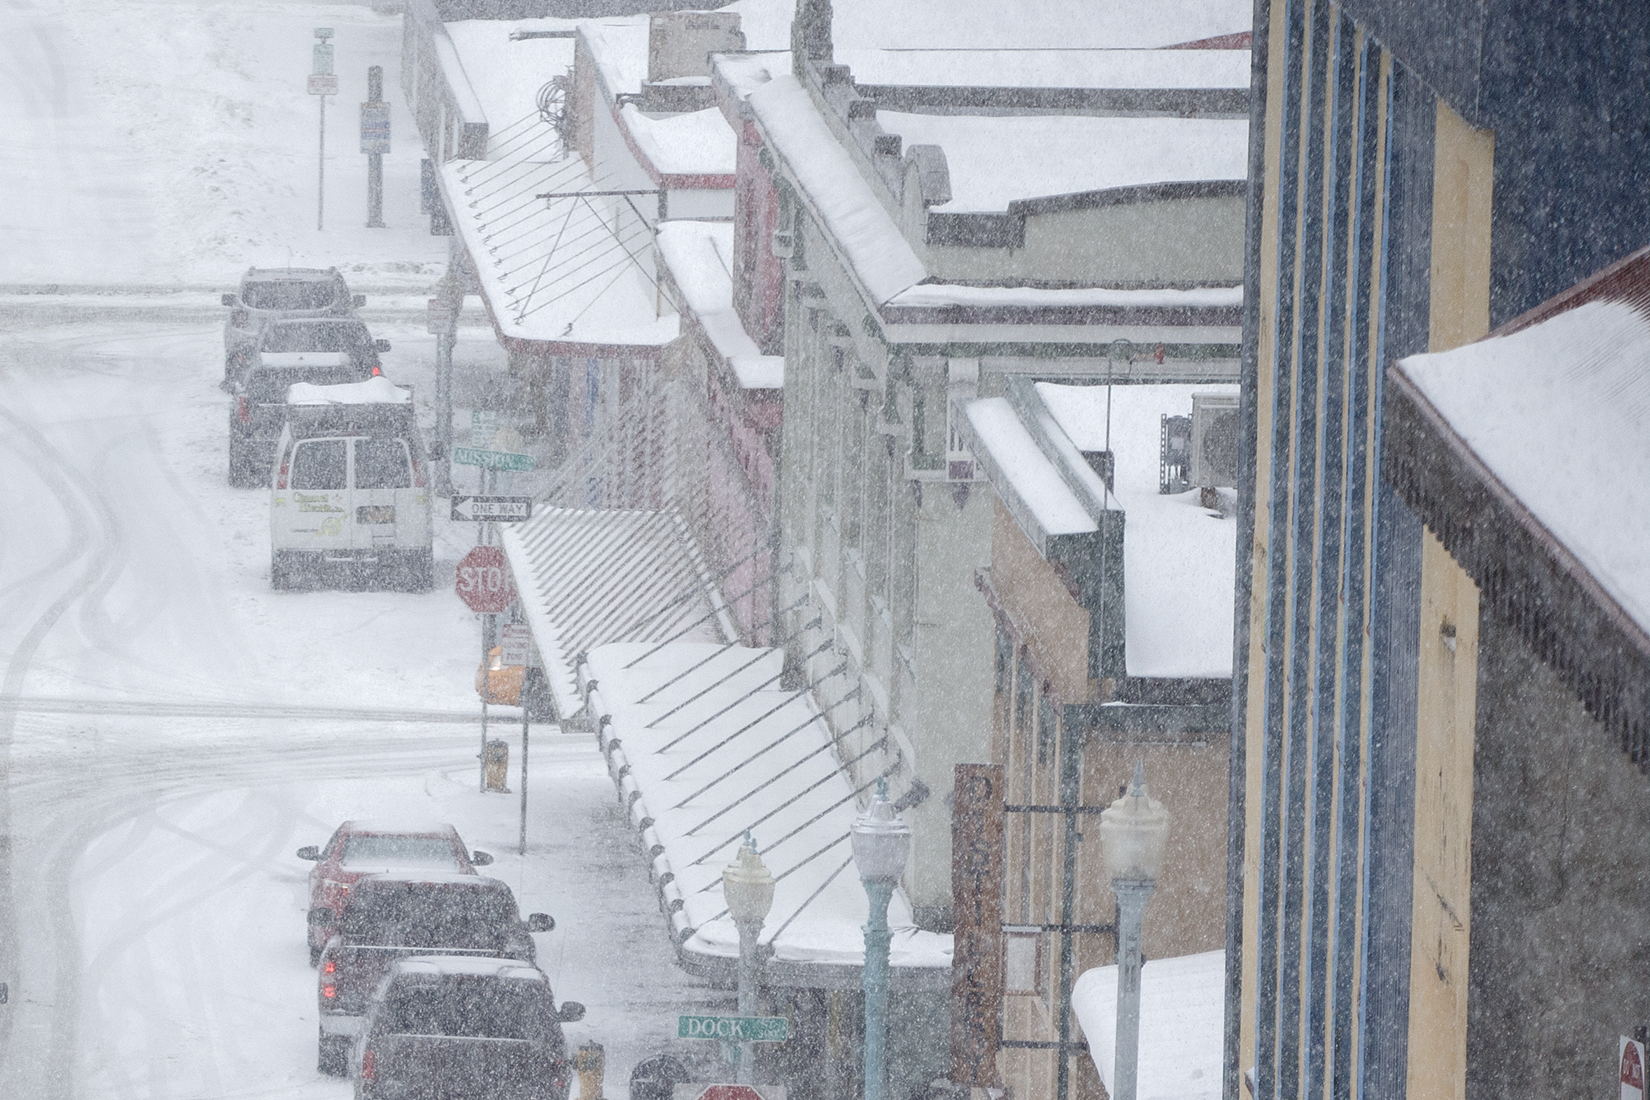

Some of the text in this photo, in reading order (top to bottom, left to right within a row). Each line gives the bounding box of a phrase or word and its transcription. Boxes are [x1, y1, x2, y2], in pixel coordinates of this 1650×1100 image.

[472, 503, 524, 514] ONE WAY
[688, 1018, 745, 1037] DOCK
